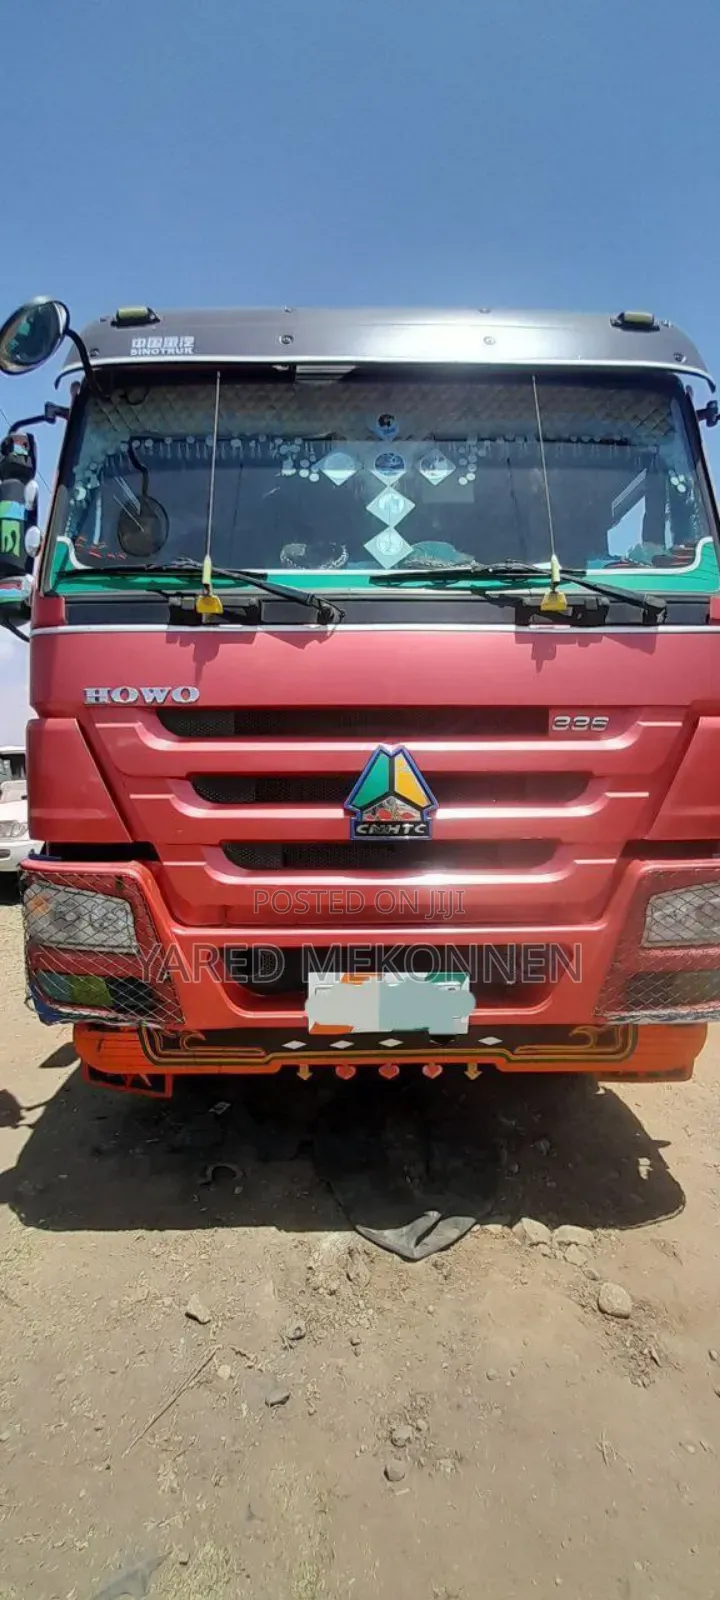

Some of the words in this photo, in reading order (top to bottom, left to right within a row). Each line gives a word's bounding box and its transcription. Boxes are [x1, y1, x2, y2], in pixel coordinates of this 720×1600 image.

[130, 347, 194, 356] SINOTRUK
[83, 686, 200, 704] HOWO
[356, 823, 427, 835] CNHTC
